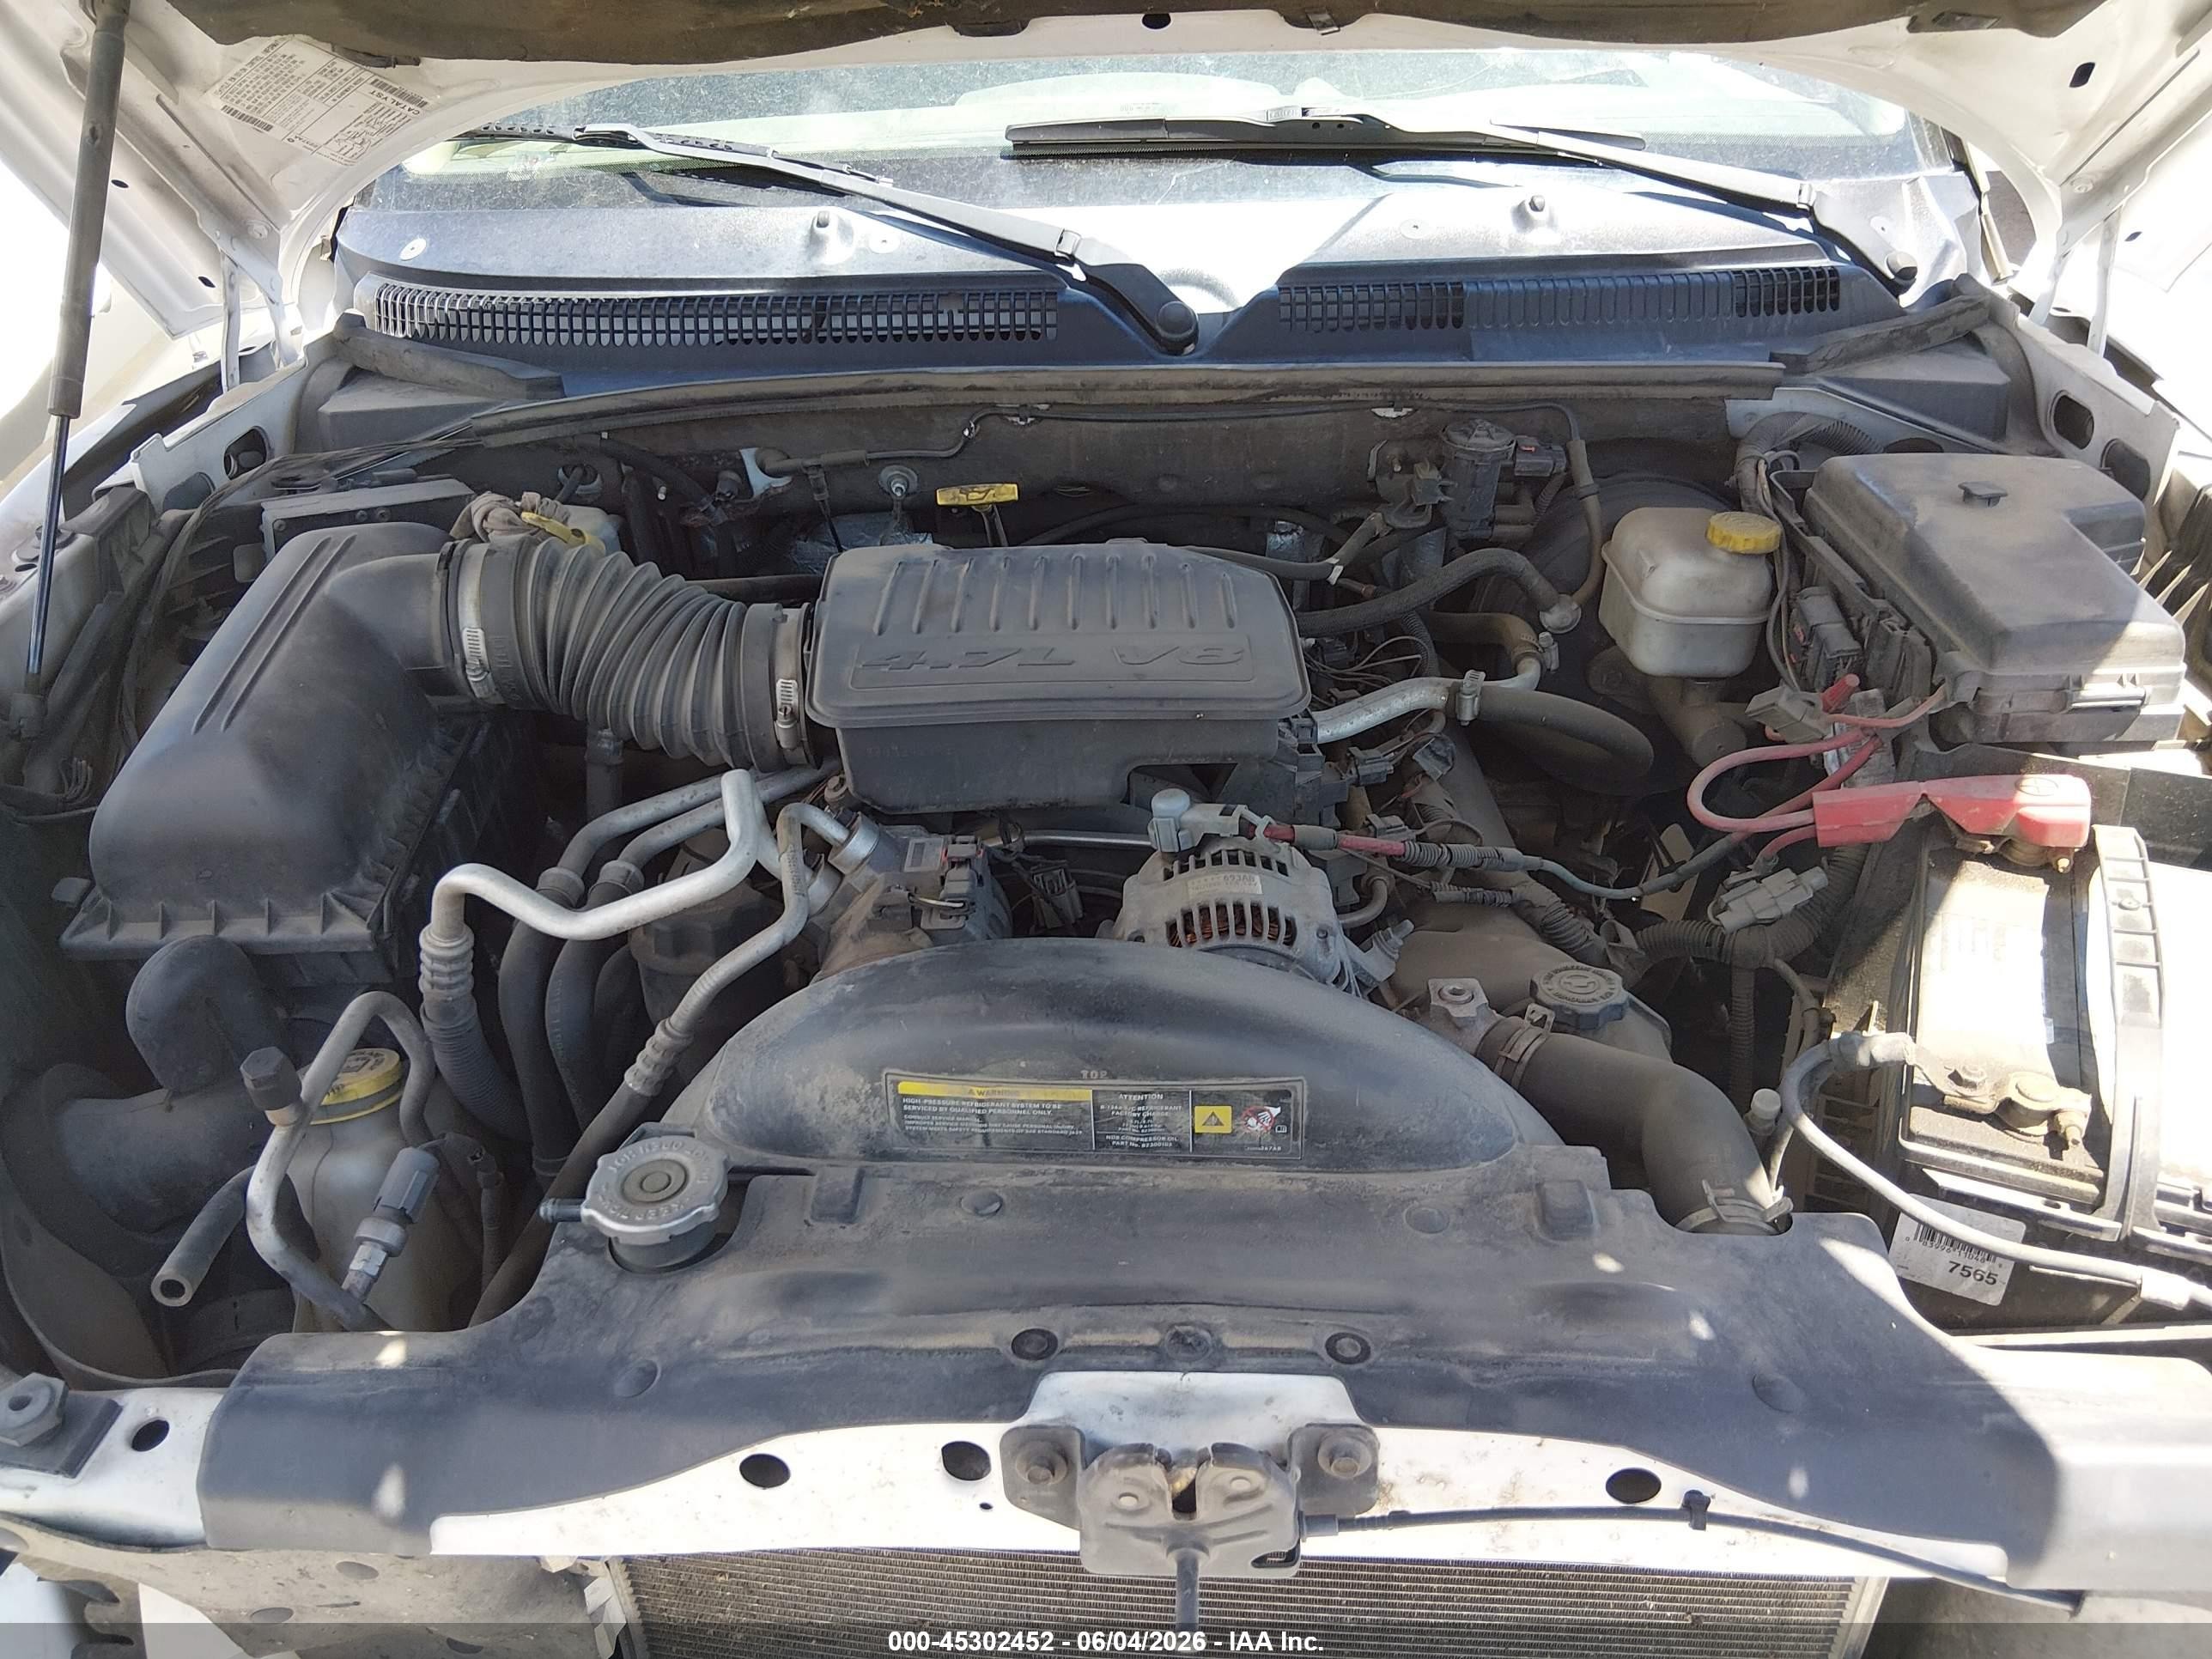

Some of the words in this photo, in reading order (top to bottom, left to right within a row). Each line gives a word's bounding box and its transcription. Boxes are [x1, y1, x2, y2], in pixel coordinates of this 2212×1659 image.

[370, 89, 421, 116] CATALYST
[862, 647, 1075, 671] 4.7L
[1113, 645, 1245, 666] V8
[1080, 1070, 1108, 1079] TOP
[949, 1106, 987, 1115] QUALIFIED
[1948, 1260, 1999, 1285] 7565
